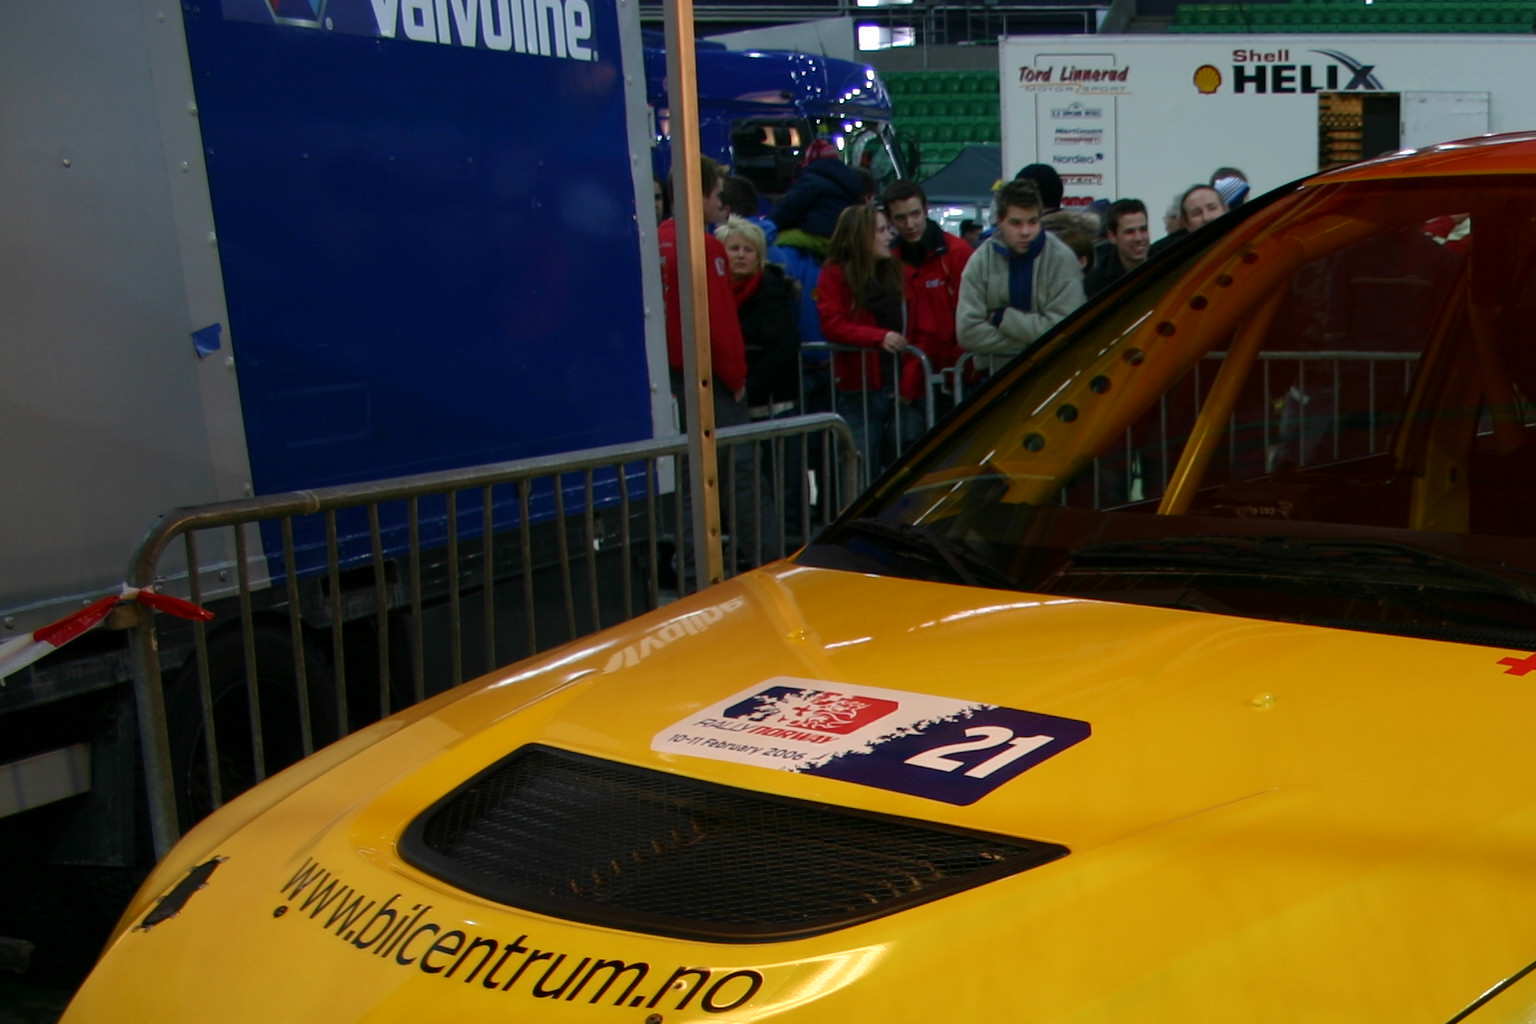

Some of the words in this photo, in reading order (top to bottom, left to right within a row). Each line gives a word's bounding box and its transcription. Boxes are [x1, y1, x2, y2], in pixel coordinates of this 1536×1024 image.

[1232, 49, 1290, 62] Shell
[1019, 66, 1053, 82] Tord
[1232, 63, 1379, 94] HELIX
[703, 737, 763, 754] February
[762, 746, 806, 761] 2006
[904, 726, 1055, 779] 21
[279, 856, 765, 1014] www.bilcentrum.no
